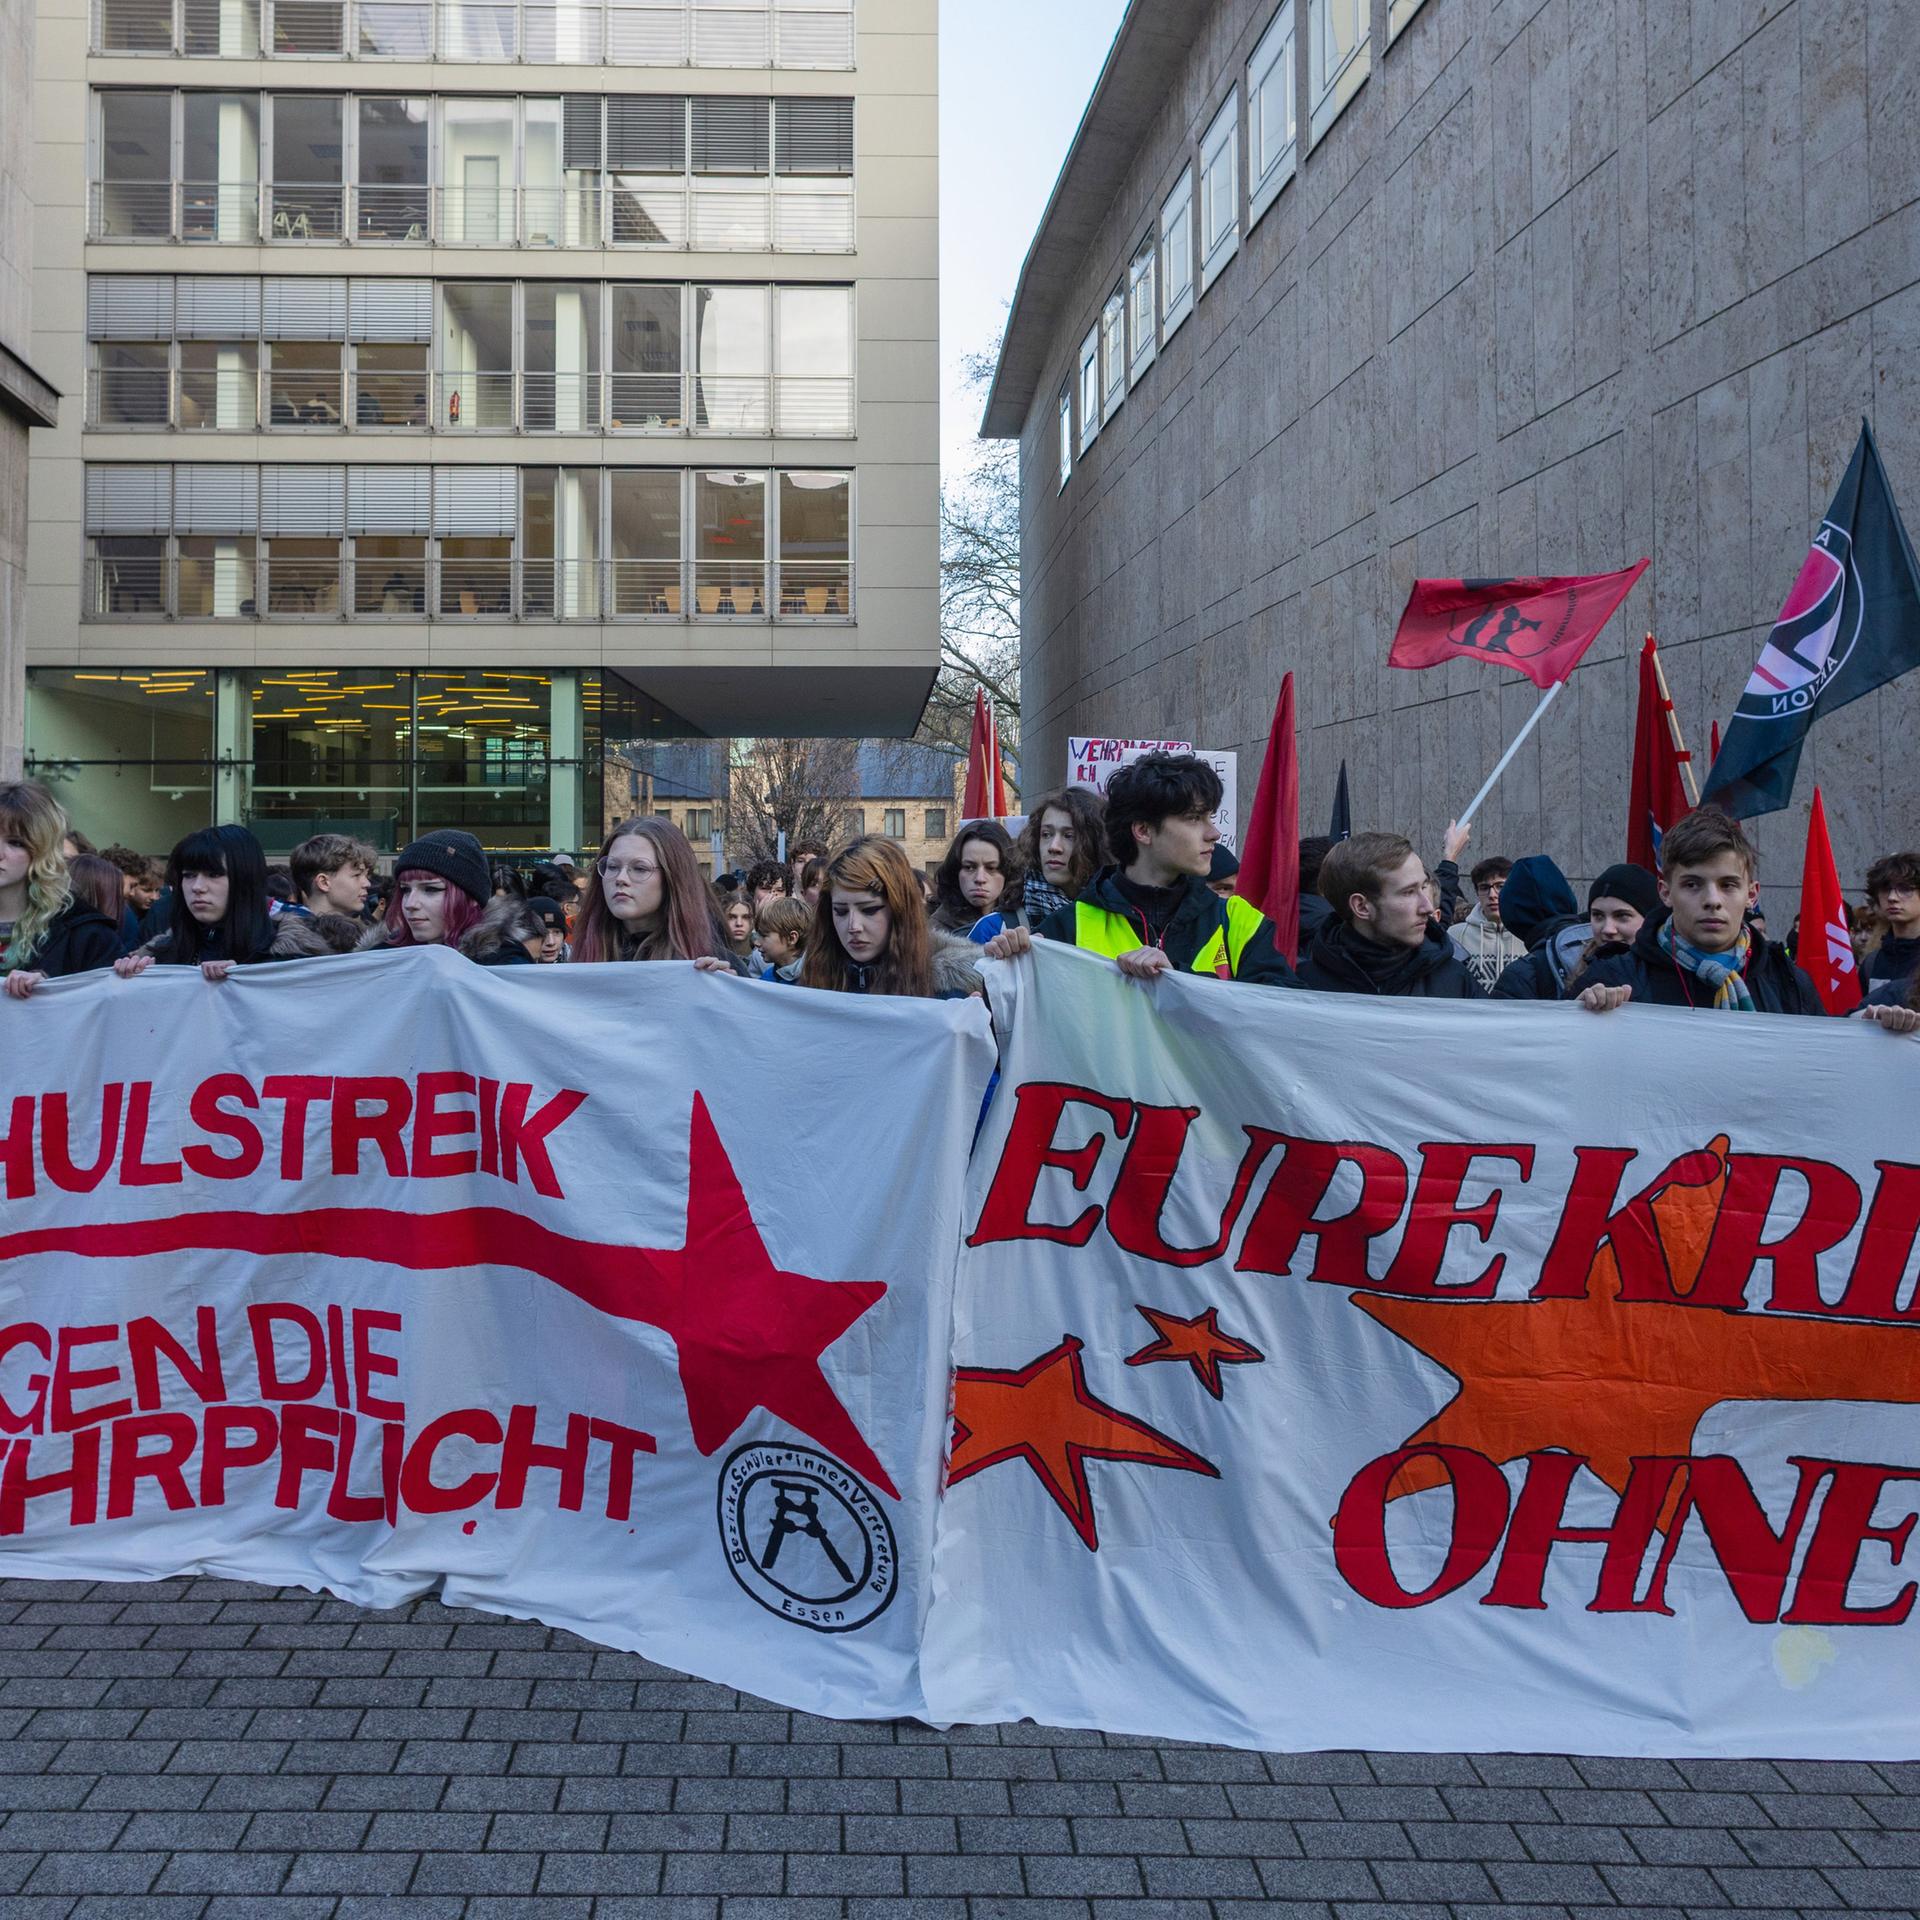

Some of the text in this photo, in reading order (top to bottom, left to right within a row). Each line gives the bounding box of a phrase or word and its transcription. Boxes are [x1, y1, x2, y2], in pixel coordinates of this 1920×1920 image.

[967, 1082, 1920, 1320] EURE KRI
[248, 1302, 405, 1421] DIE
[0, 1404, 657, 1535] HRPFLICHT
[1332, 1443, 1920, 1625] OHNE
[782, 1599, 845, 1622] Essen
